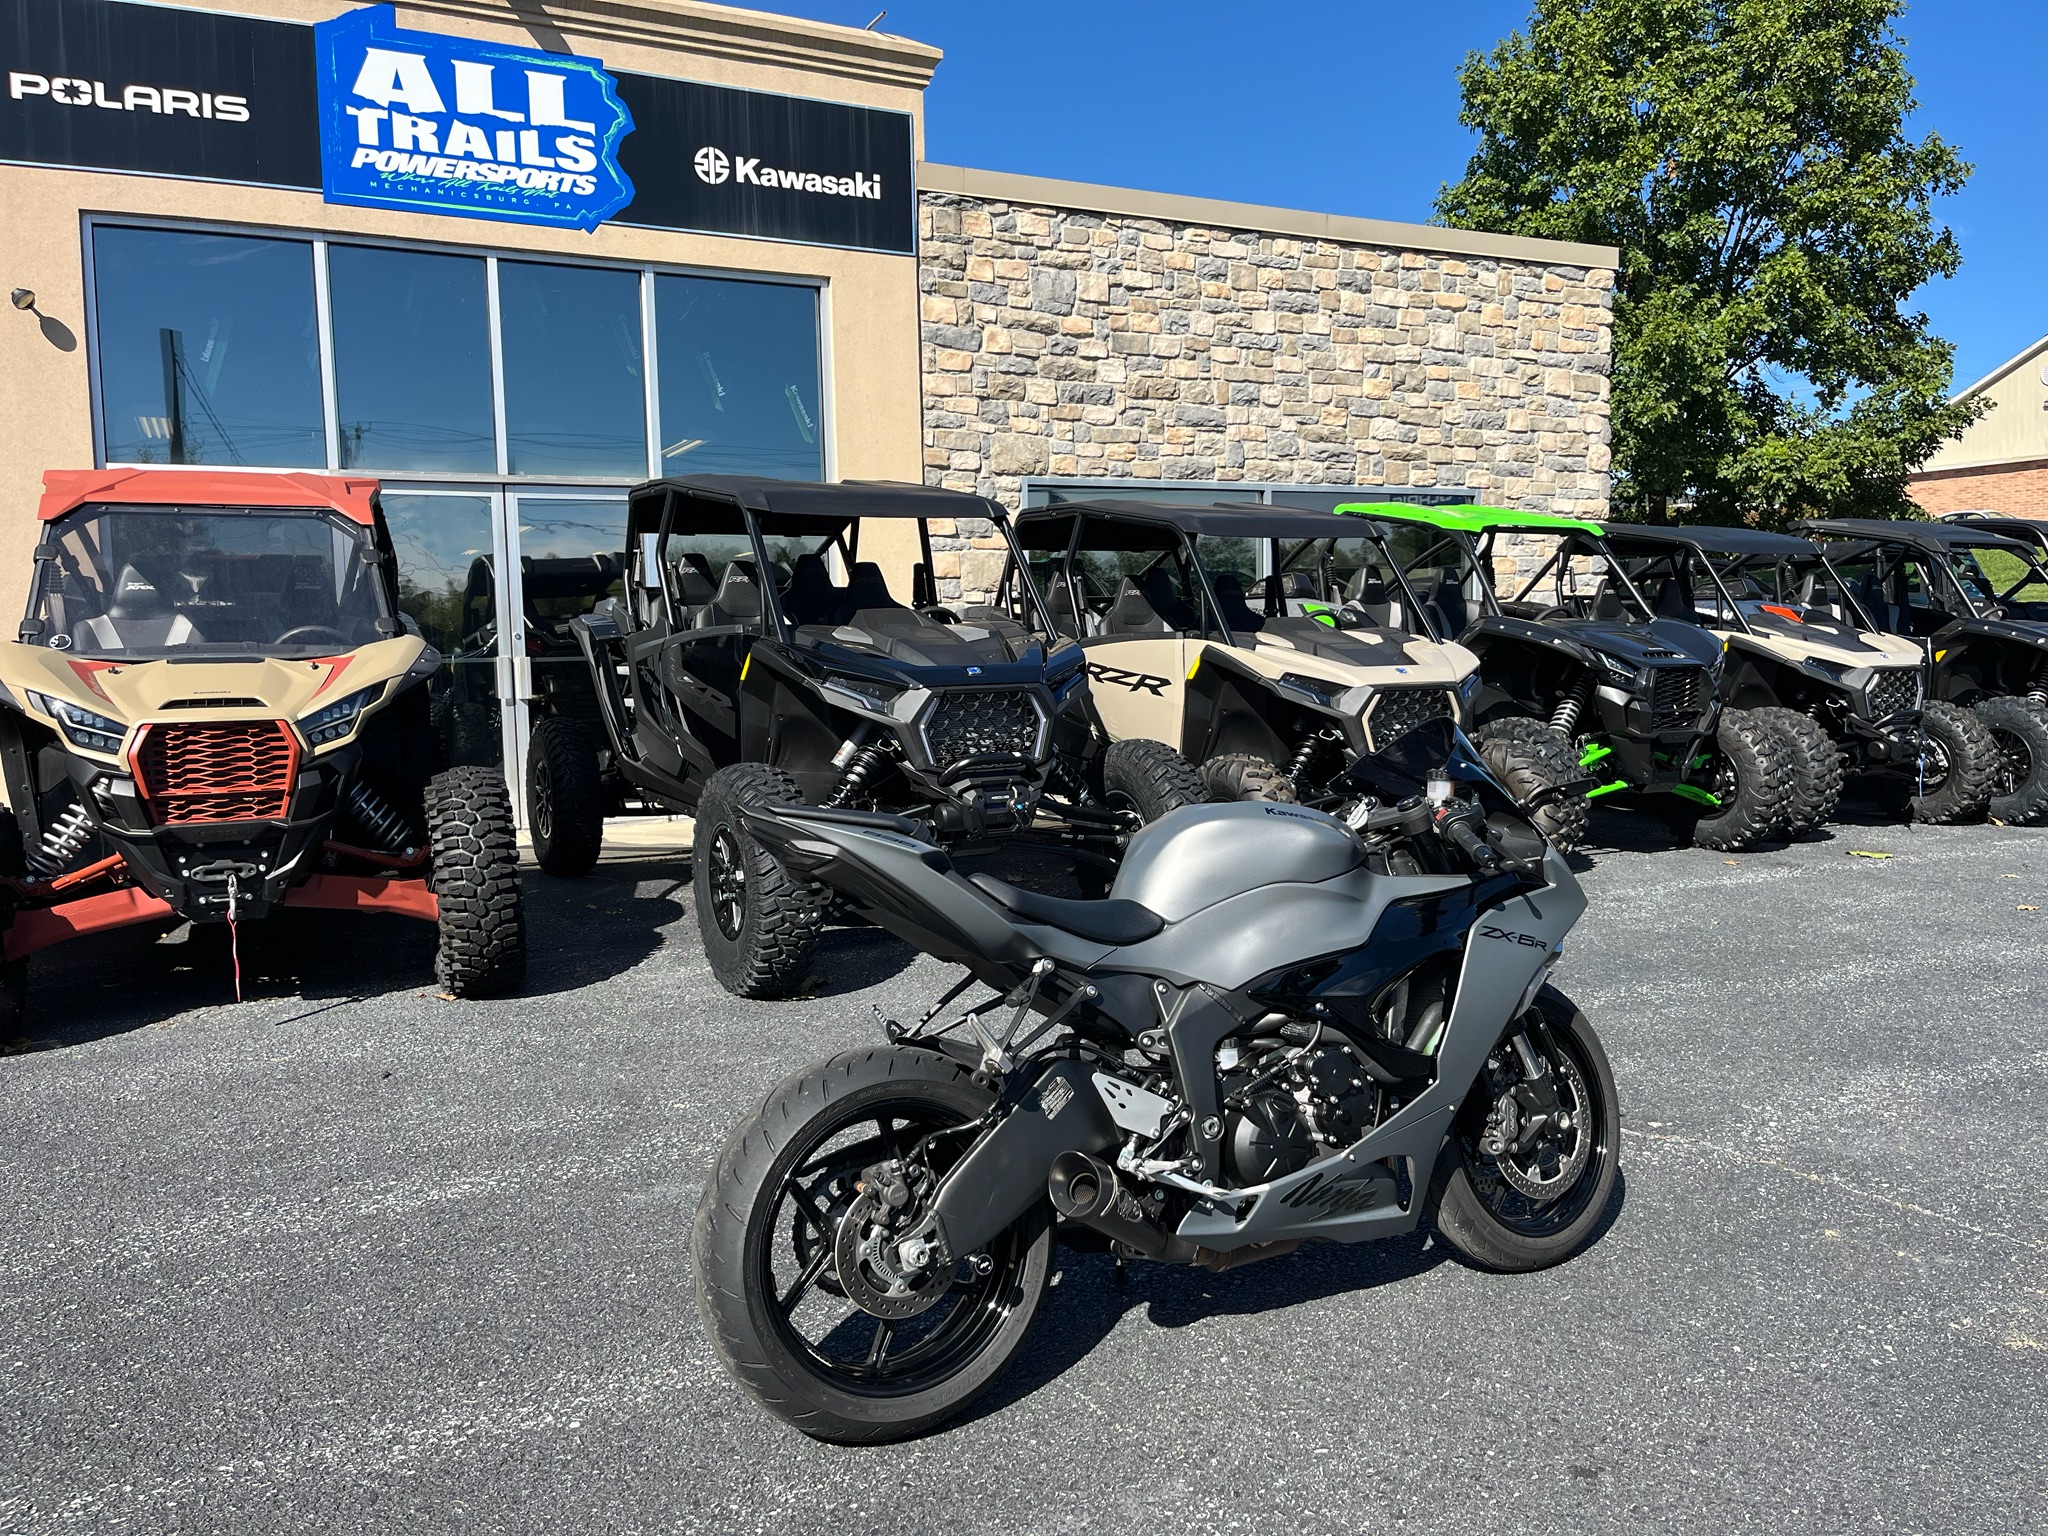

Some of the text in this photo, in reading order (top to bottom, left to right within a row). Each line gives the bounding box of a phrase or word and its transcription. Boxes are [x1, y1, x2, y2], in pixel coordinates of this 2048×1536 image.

[9, 71, 250, 122] POLARIS
[352, 47, 596, 136] ALL
[346, 105, 597, 172] TRAILS
[351, 147, 597, 195] POWERSPORTS
[379, 171, 436, 184] Where
[438, 177, 470, 188] All
[475, 180, 517, 195] Trails
[735, 156, 881, 200] Kawasaki
[554, 202, 572, 210] PA
[1087, 660, 1173, 698] RZR
[1478, 925, 1548, 952] ZX-6R
[1279, 1172, 1378, 1221] Ninja
